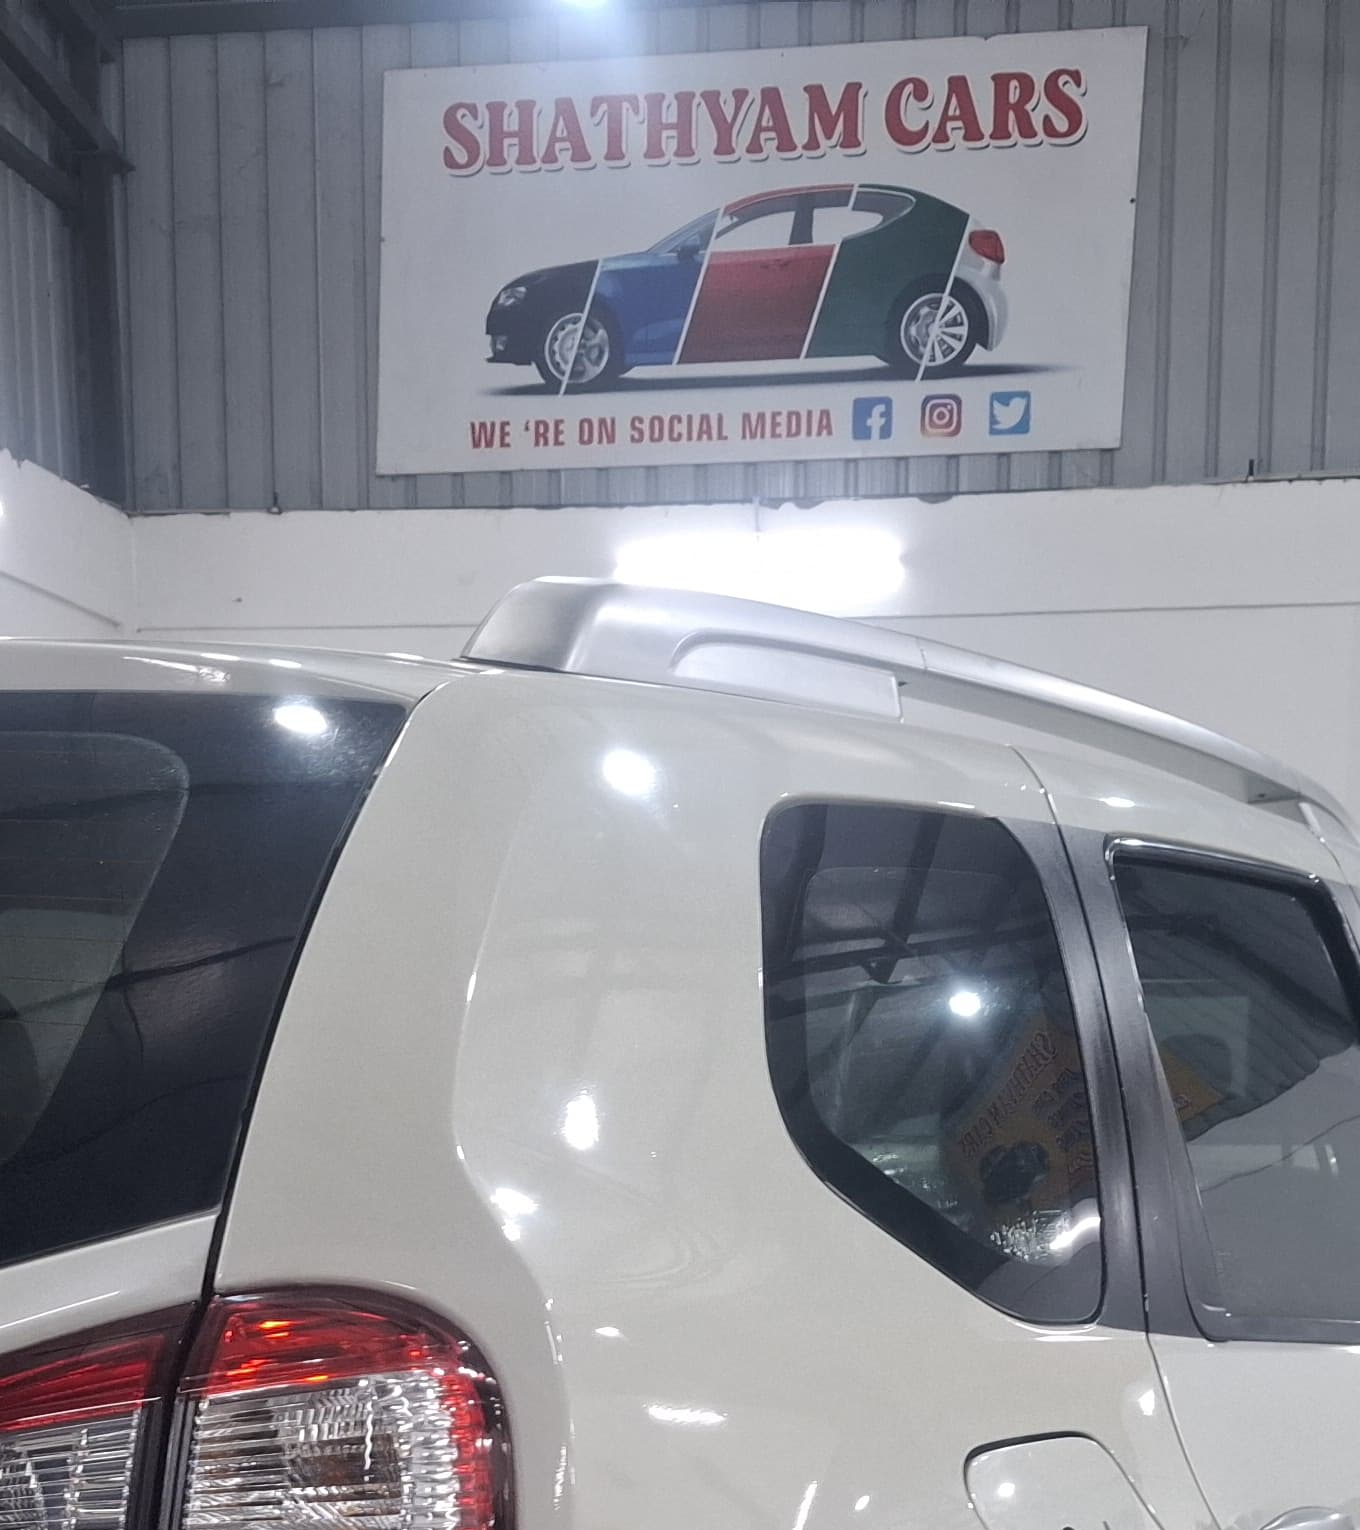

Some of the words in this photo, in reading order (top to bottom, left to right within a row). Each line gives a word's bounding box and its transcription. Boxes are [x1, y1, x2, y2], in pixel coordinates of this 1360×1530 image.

[441, 80, 866, 172] SHATHYAM
[883, 68, 1087, 148] CARS
[469, 419, 513, 450] WE
[578, 415, 617, 446] ON
[629, 411, 731, 444] SOCIAL
[740, 407, 835, 440] MEDIA
